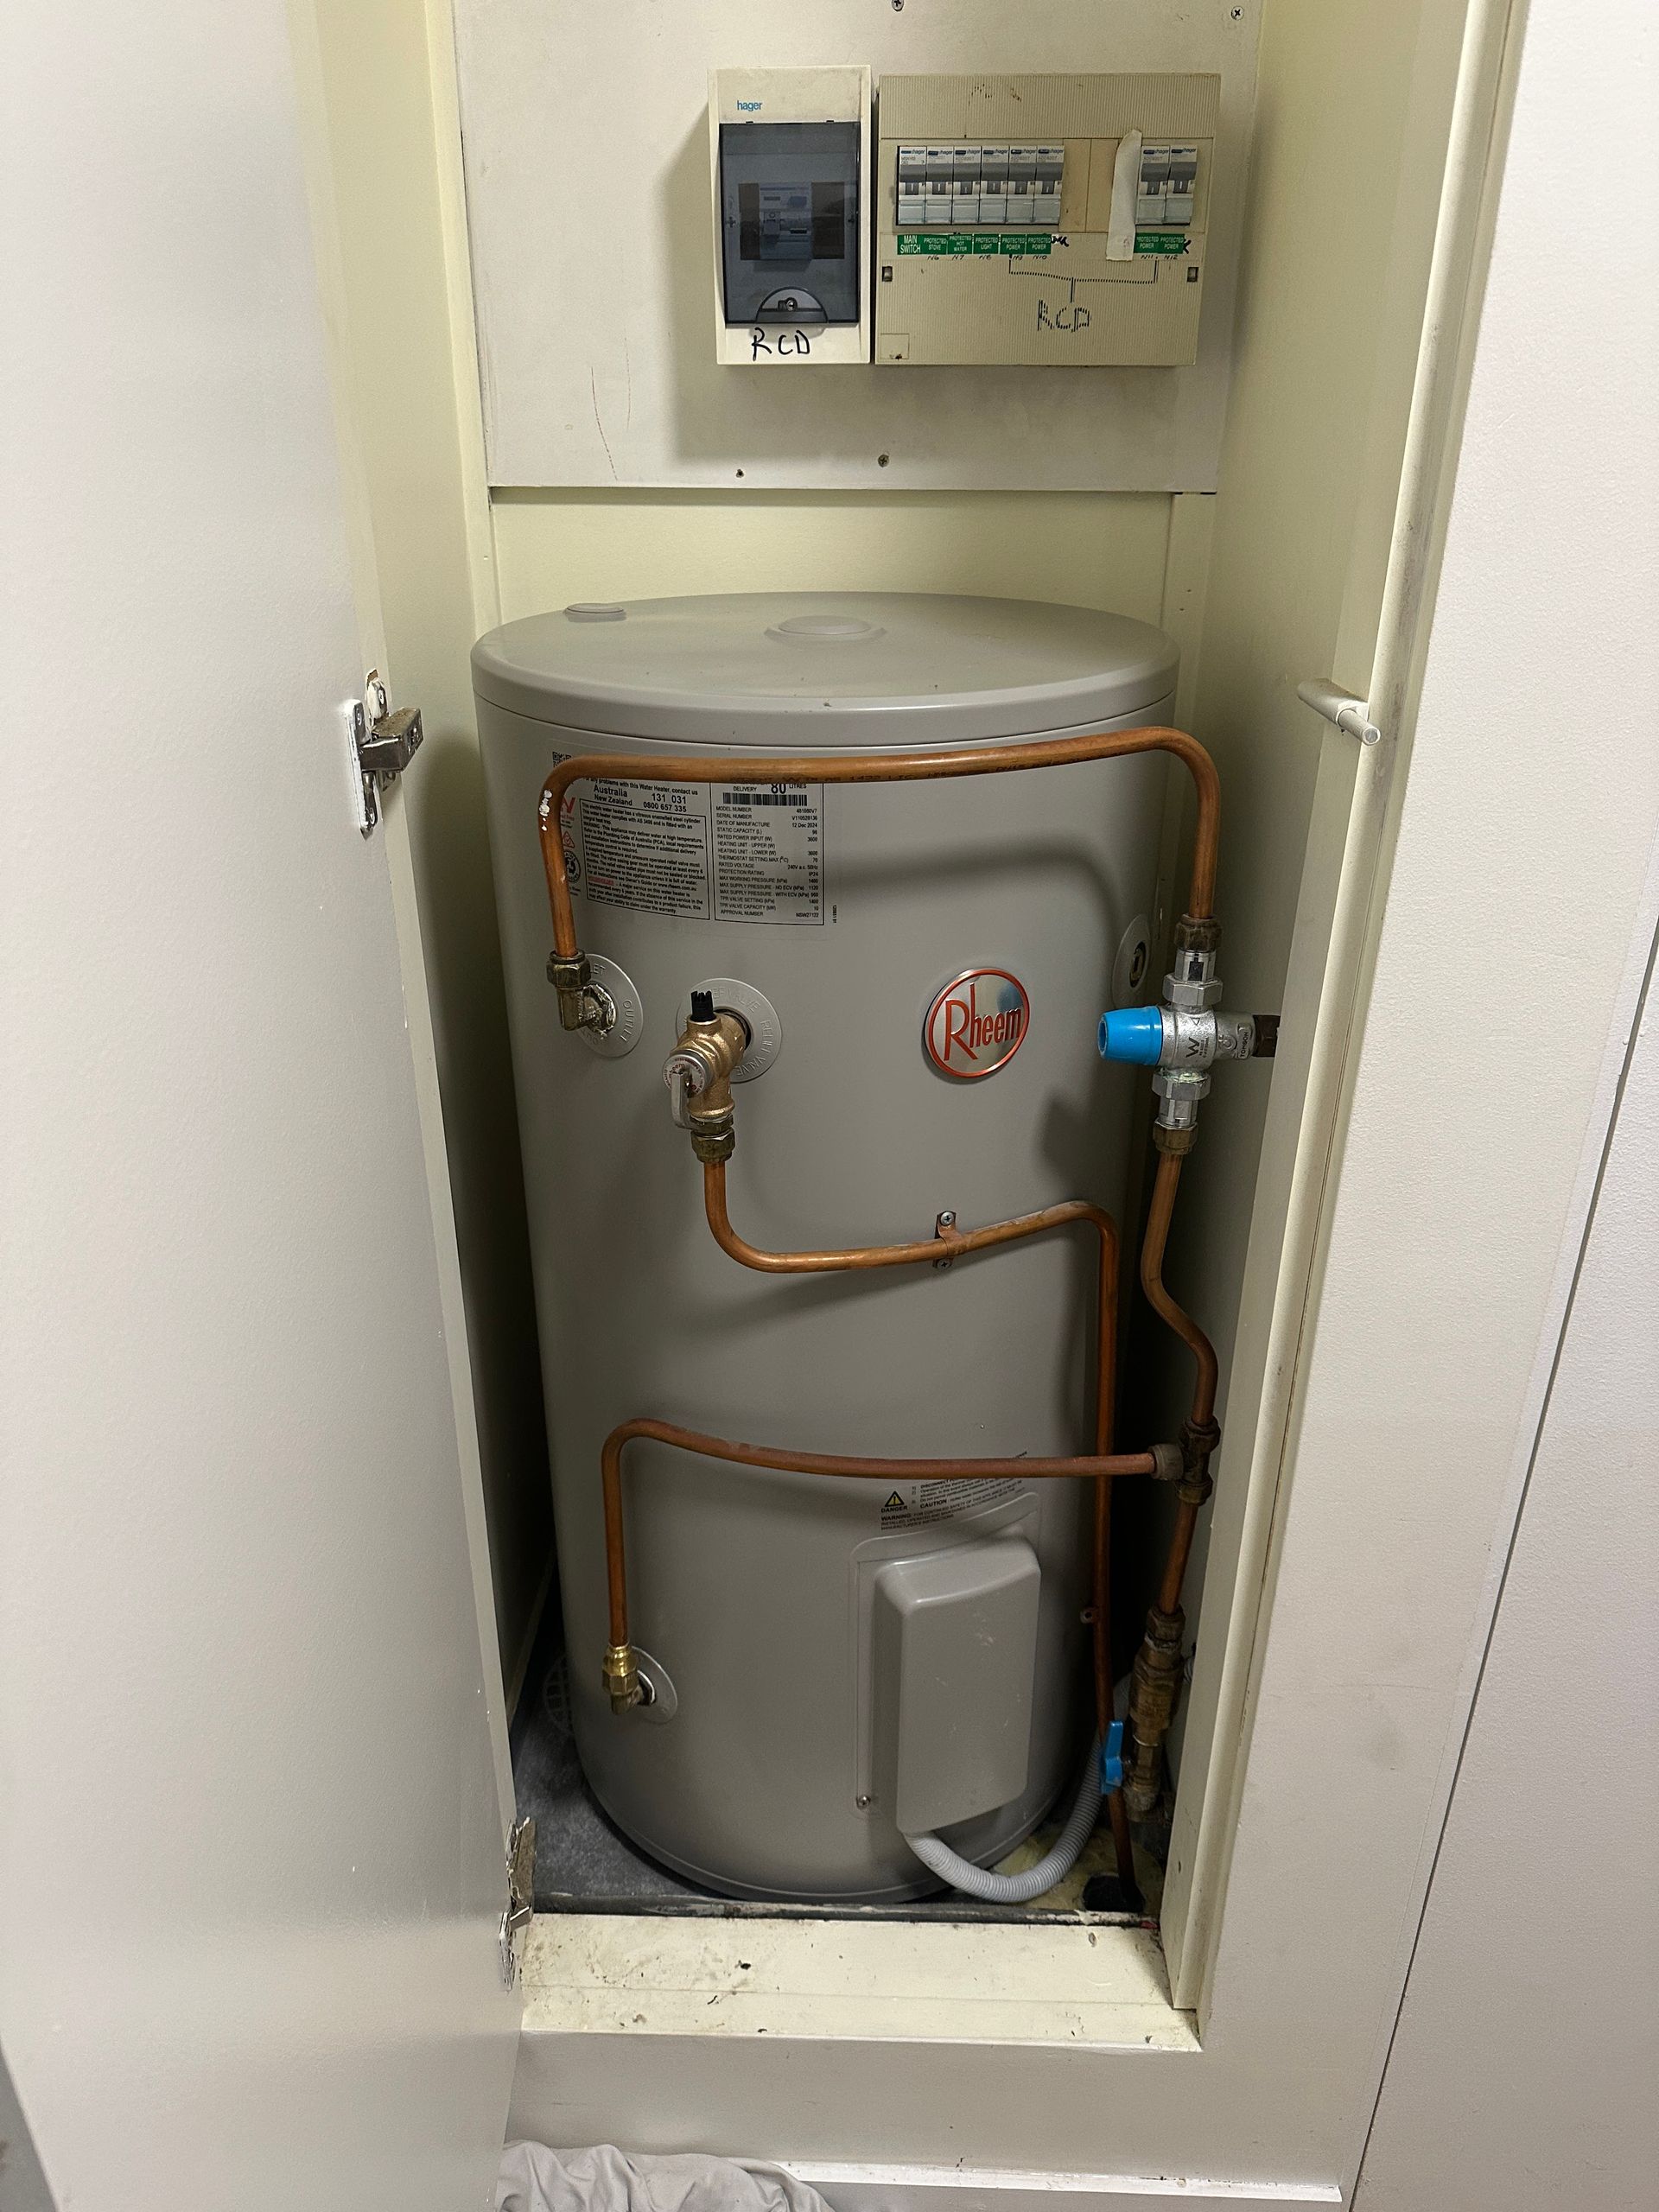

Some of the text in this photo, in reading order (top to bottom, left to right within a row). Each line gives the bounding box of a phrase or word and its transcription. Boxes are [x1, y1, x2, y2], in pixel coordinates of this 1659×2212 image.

[737, 99, 763, 112] hager
[903, 235, 917, 244] MAIN
[900, 244, 921, 254] SWITCH
[1037, 299, 1091, 333] RCD
[751, 327, 810, 361] RCD
[594, 785, 686, 804] Australia 131 031
[771, 783, 786, 794] 80
[594, 794, 607, 802] New
[608, 796, 632, 806] Zealand
[944, 982, 1021, 1061] Rheem
